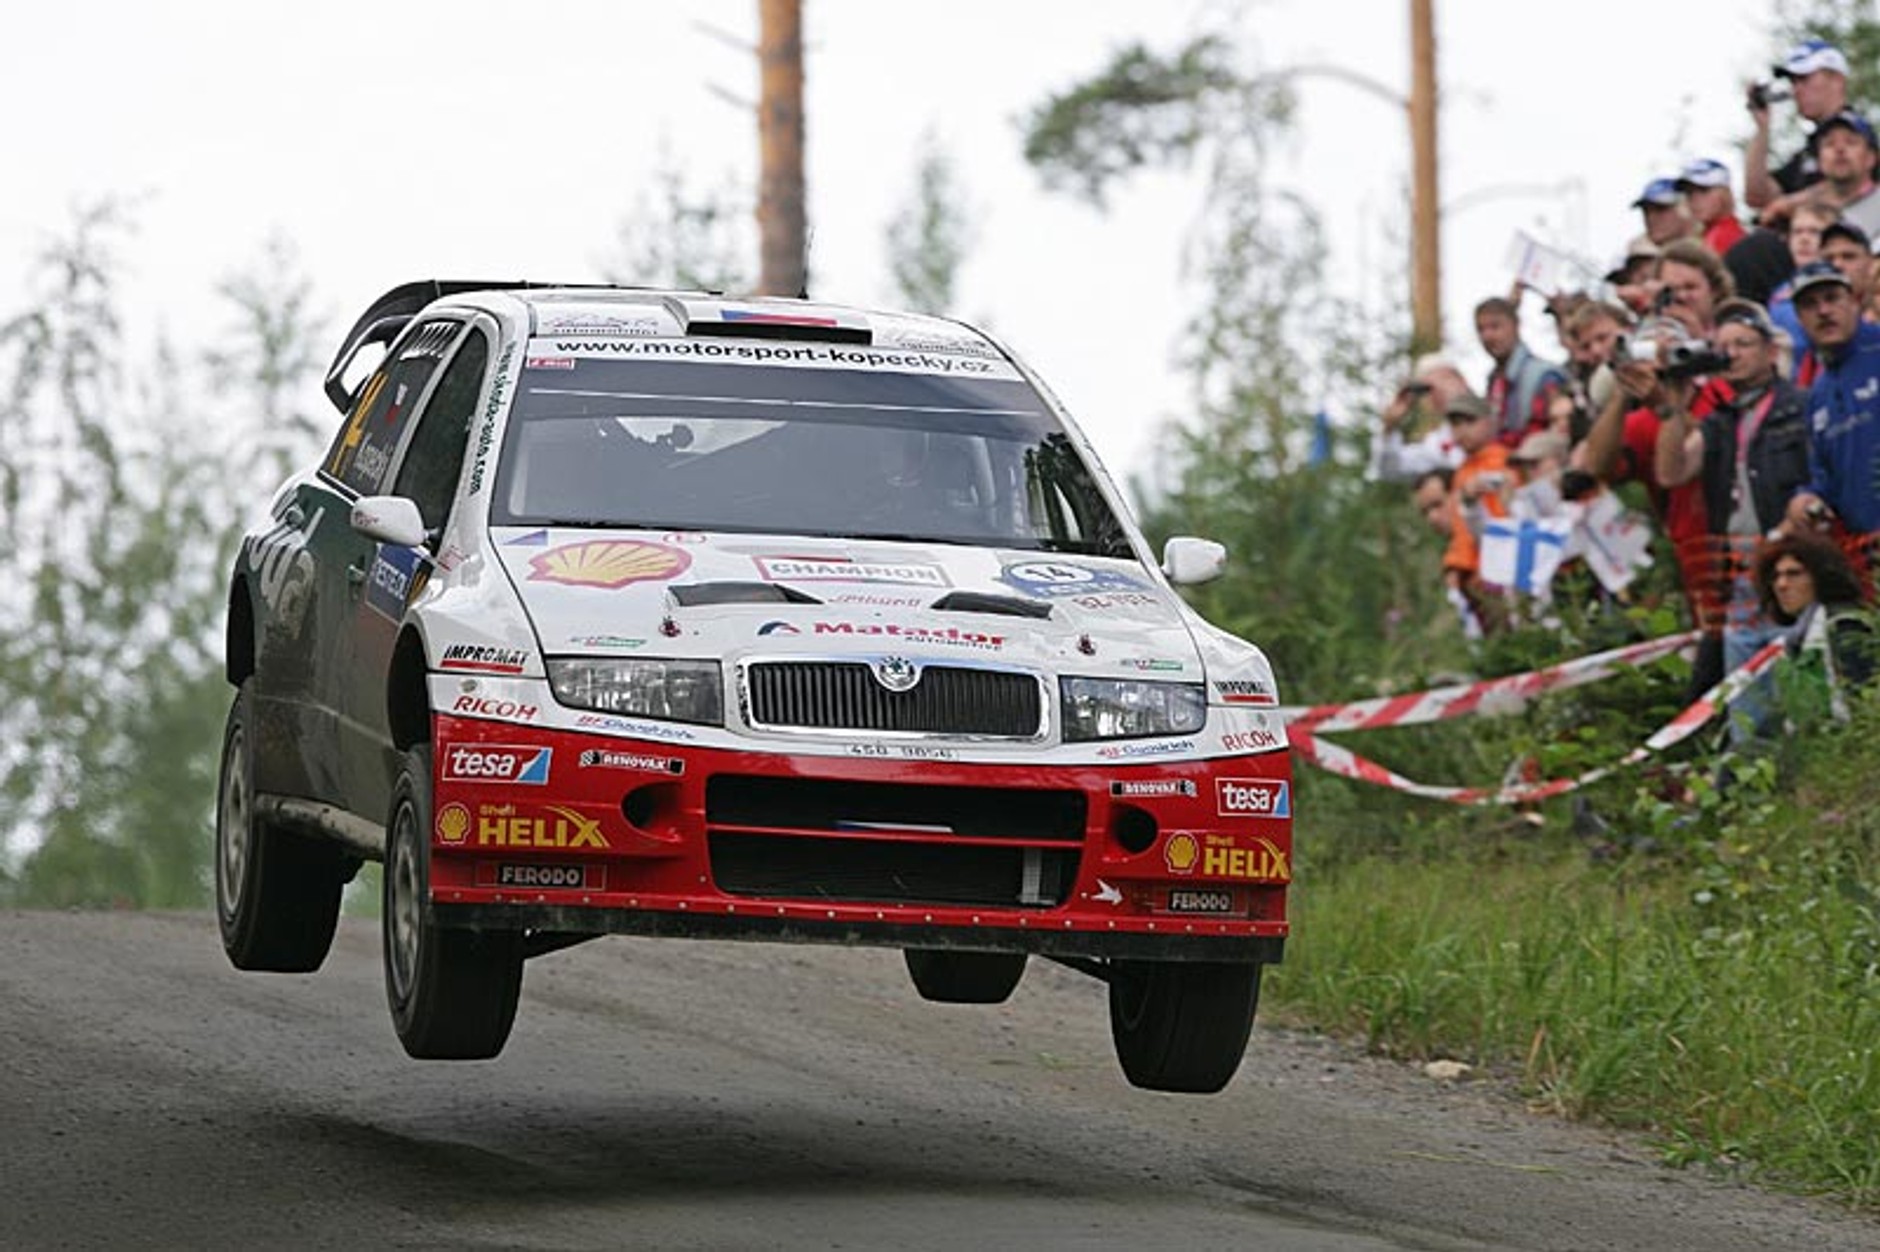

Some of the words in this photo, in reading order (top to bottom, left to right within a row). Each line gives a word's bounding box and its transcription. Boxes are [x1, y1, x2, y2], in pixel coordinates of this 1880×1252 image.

[556, 340, 994, 373] www.motorsport-kopecky.cz
[771, 560, 935, 582] CHAMPION
[1025, 565, 1077, 580] 14
[814, 622, 1006, 645] Matador
[443, 645, 529, 665] IMPROMAT
[453, 695, 538, 721] RICOH
[1222, 730, 1277, 751] RICOH
[452, 748, 516, 777] tesa
[603, 755, 667, 769] RENOVAX
[1222, 782, 1271, 811] tesa
[478, 809, 609, 848] HELIX
[1203, 838, 1290, 879] HELIX
[502, 866, 580, 885] FERODO
[1172, 893, 1230, 911] FERODO
